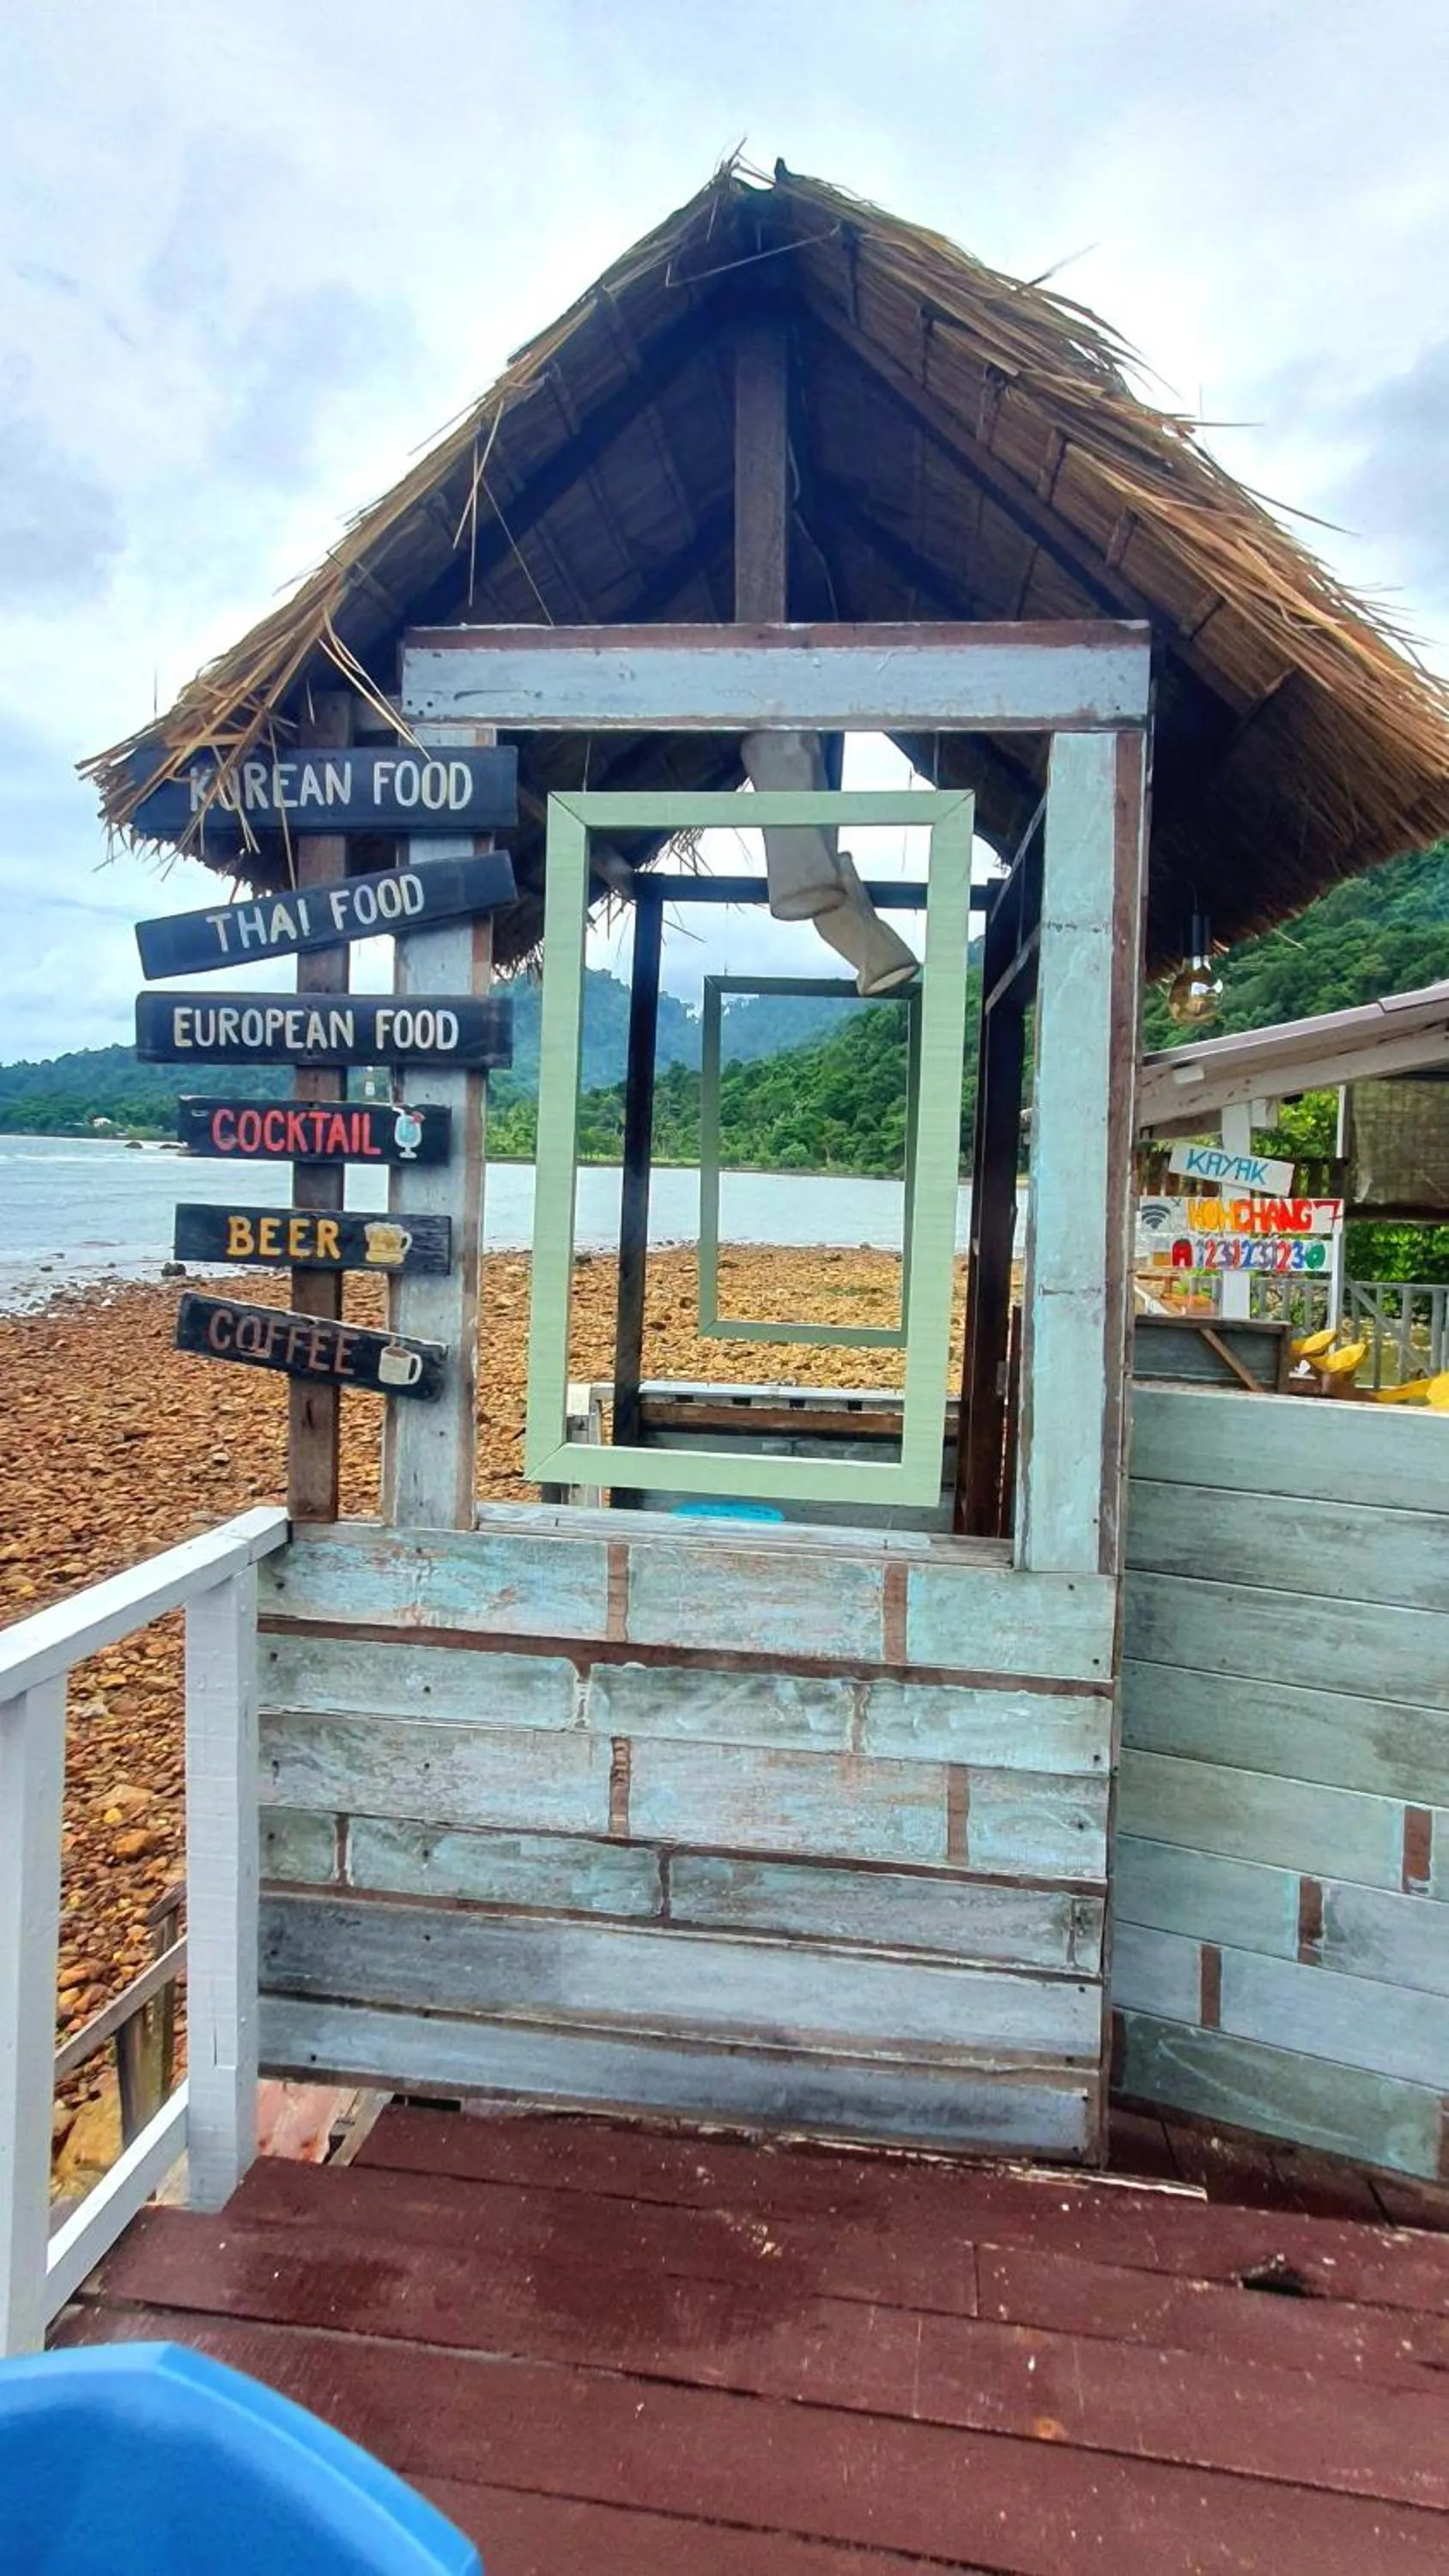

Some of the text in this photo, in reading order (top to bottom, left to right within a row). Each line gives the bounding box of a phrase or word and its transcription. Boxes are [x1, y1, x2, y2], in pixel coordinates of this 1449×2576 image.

[189, 760, 472, 811] KOREAN FOOD
[206, 873, 425, 953] THAI FOOD
[173, 1006, 458, 1050] EUROPEAN FOOD
[211, 1109, 382, 1155] COCKTAIL
[1185, 1148, 1270, 1185] KAYAK
[226, 1216, 341, 1261] BEER
[208, 1309, 359, 1375] COFFEE
